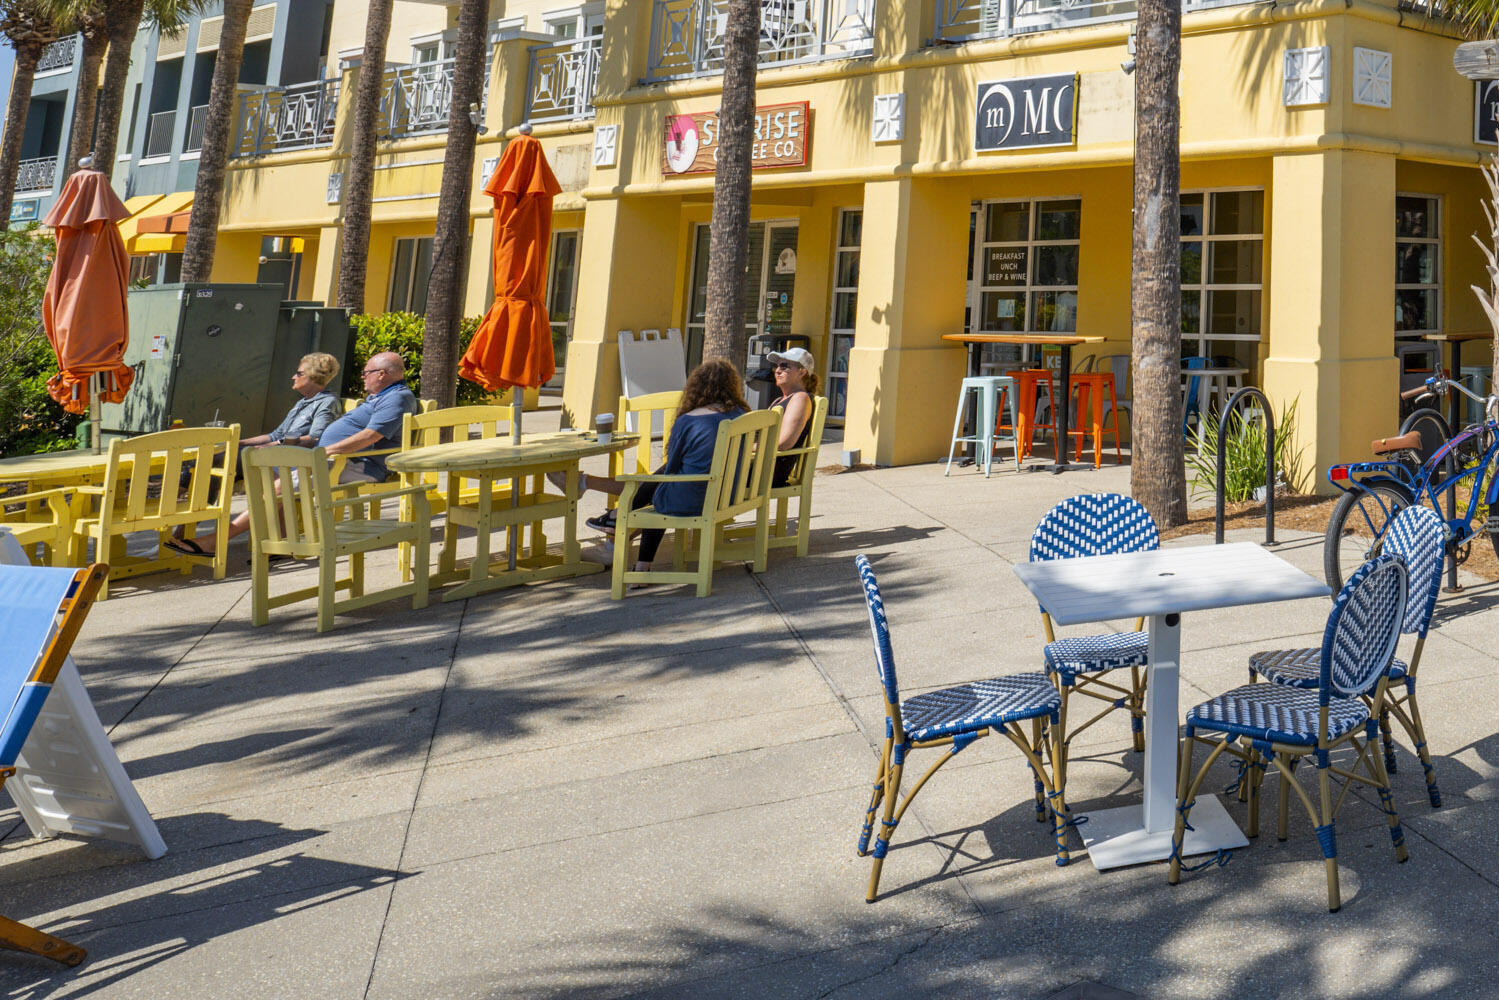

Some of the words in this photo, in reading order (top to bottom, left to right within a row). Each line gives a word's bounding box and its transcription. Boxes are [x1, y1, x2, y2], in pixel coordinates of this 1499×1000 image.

[702, 110, 800, 146] SRISE
[774, 140, 798, 158] CO.
[991, 252, 1025, 261] BREAKFAST
[1010, 272, 1027, 281] WINE
